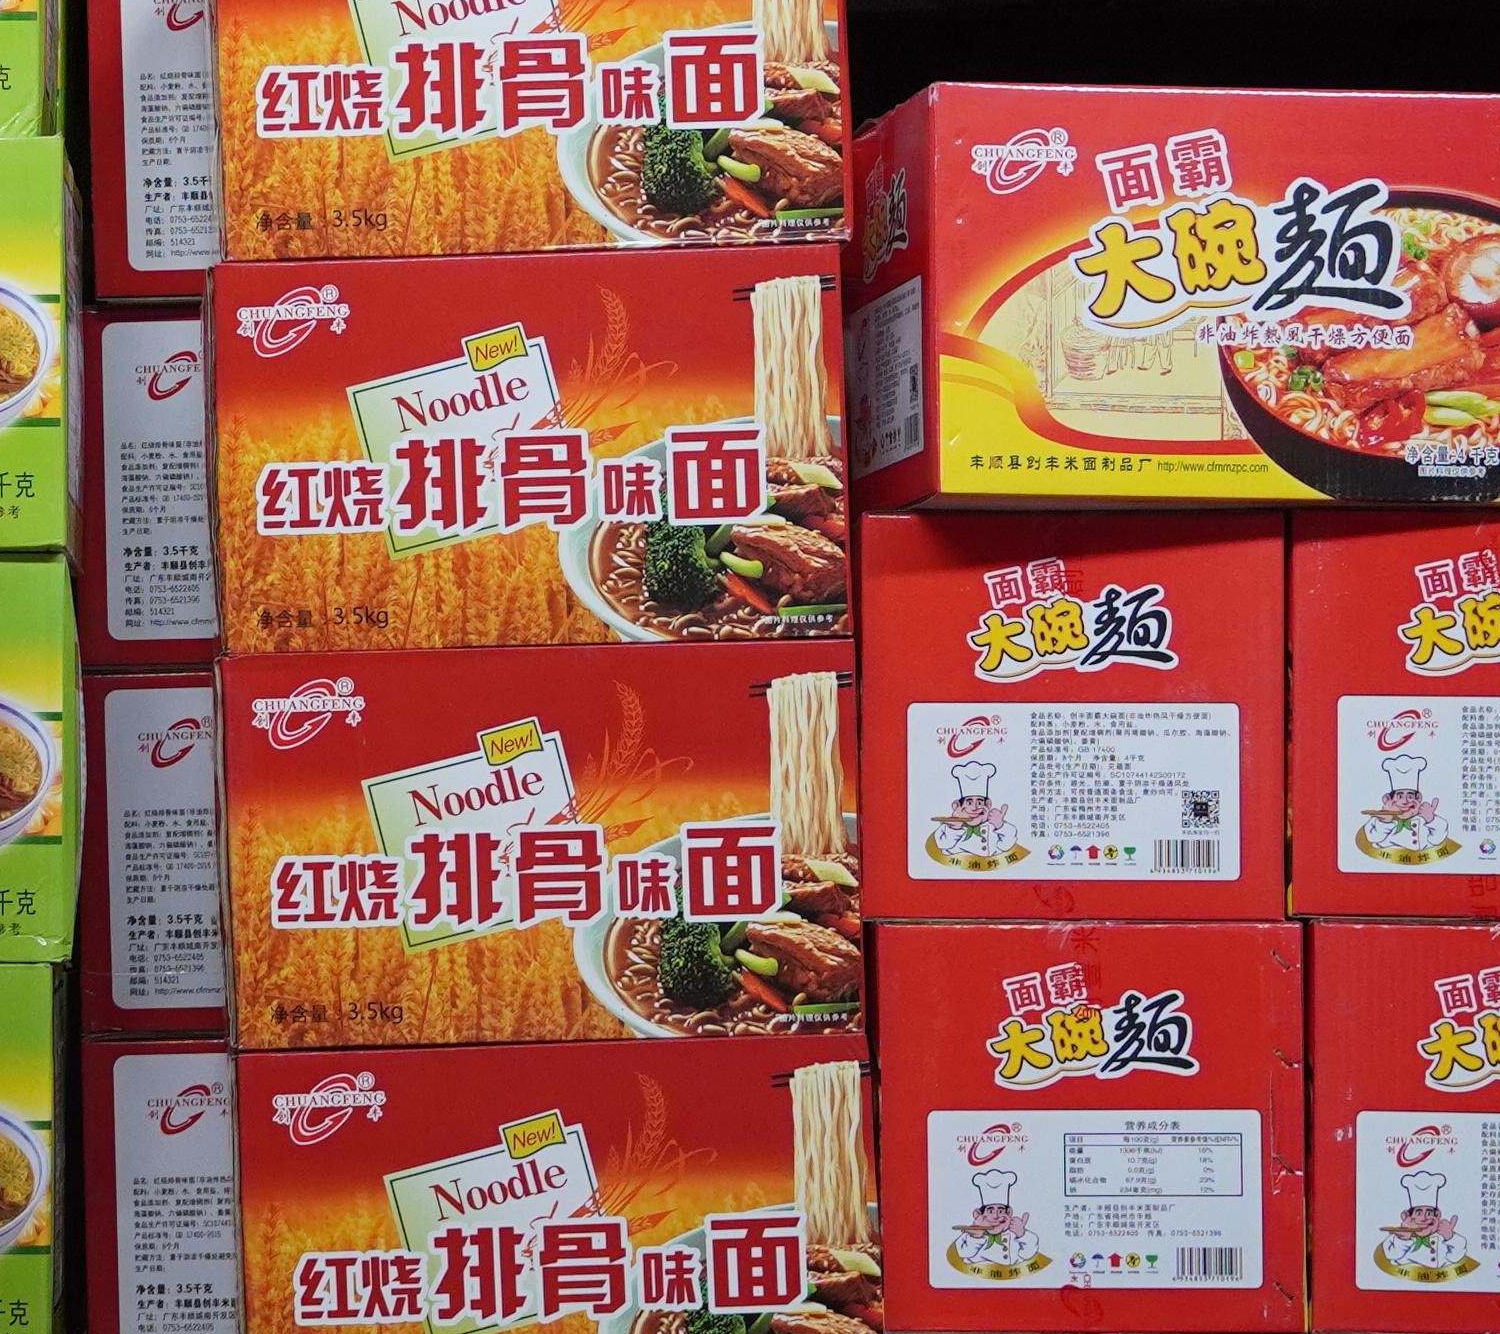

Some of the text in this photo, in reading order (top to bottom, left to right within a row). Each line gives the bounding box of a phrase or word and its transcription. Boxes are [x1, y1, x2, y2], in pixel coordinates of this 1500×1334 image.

[257, 31, 765, 135] 红烧排骨味面
[972, 145, 1075, 161] CHUANGFENG
[1099, 136, 1230, 207] 面霸
[1075, 184, 1404, 319] 大碗麵
[392, 371, 530, 433] Noodle
[258, 425, 768, 534] 红烧排骨味面
[969, 454, 1152, 471] 丰顺县创丰米面制品厂
[985, 559, 1064, 602] 面霸
[294, 1215, 808, 1324] 红烧排骨味面
